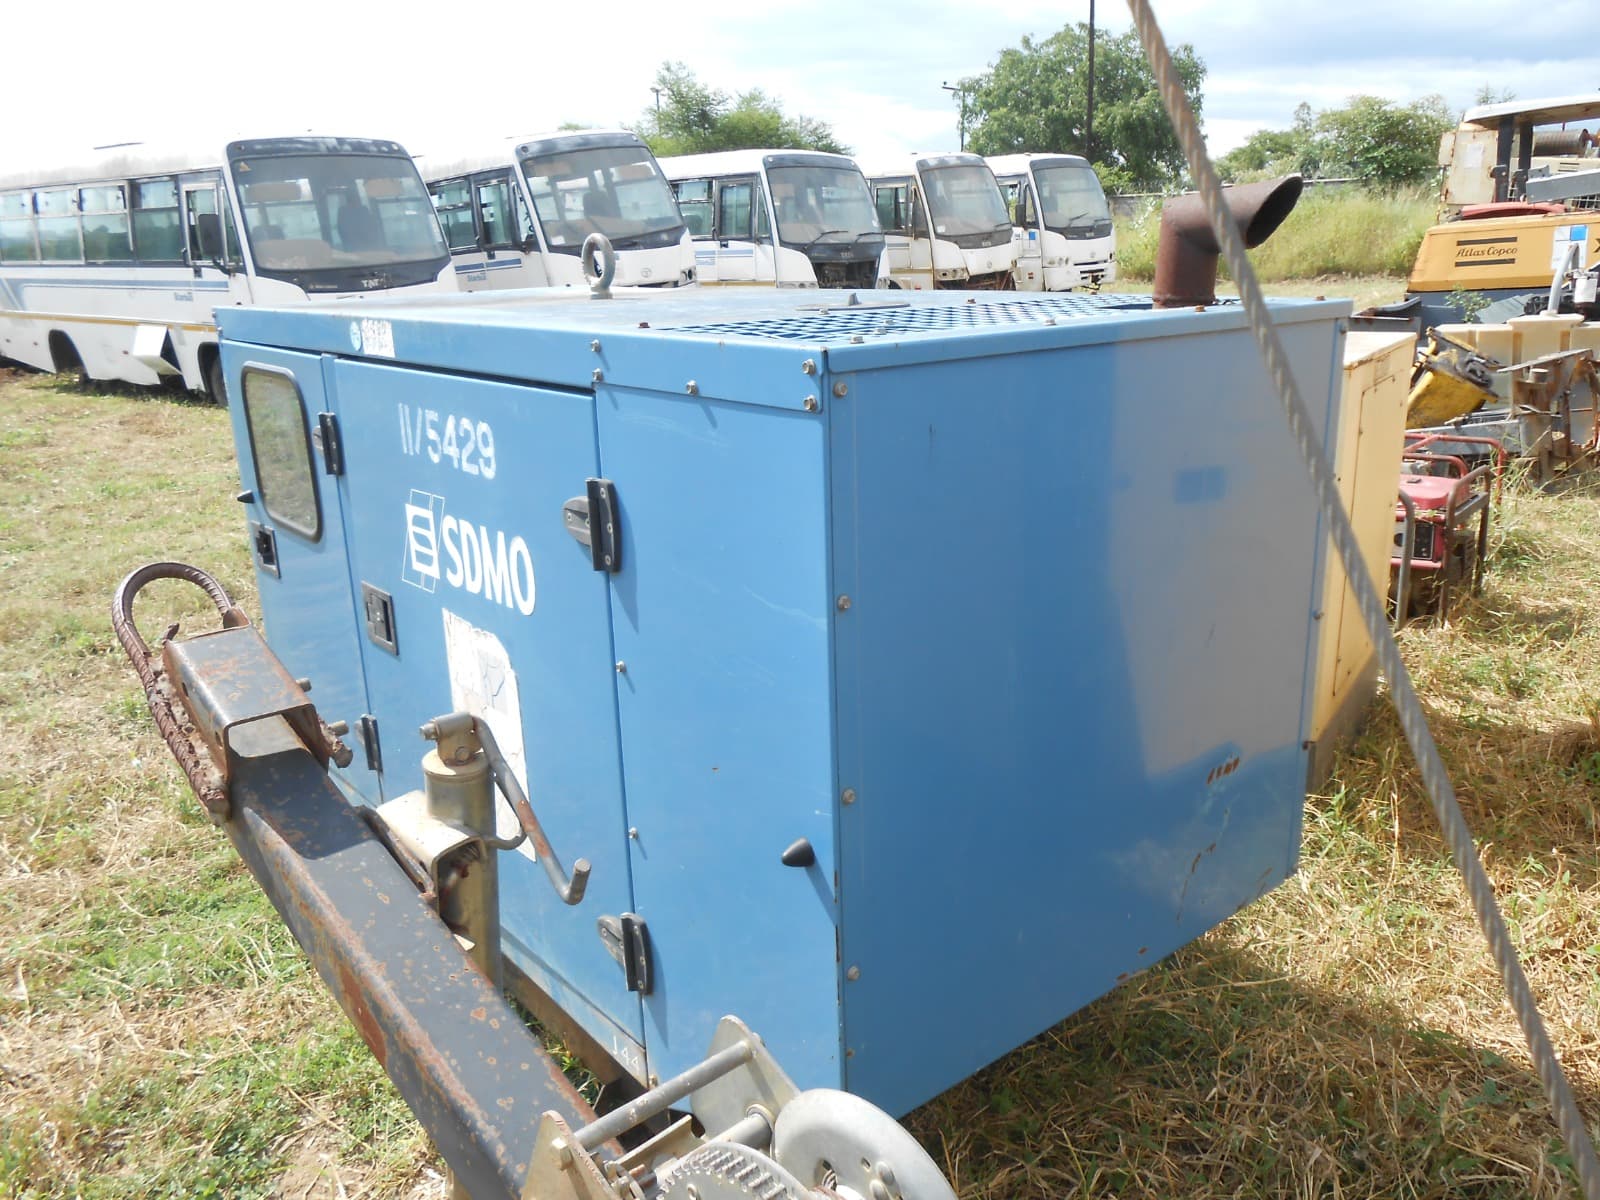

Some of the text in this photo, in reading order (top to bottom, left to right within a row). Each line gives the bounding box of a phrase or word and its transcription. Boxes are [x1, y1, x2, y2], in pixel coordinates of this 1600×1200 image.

[1456, 246, 1518, 257] Atlas Copco
[442, 514, 536, 616] SDMO
